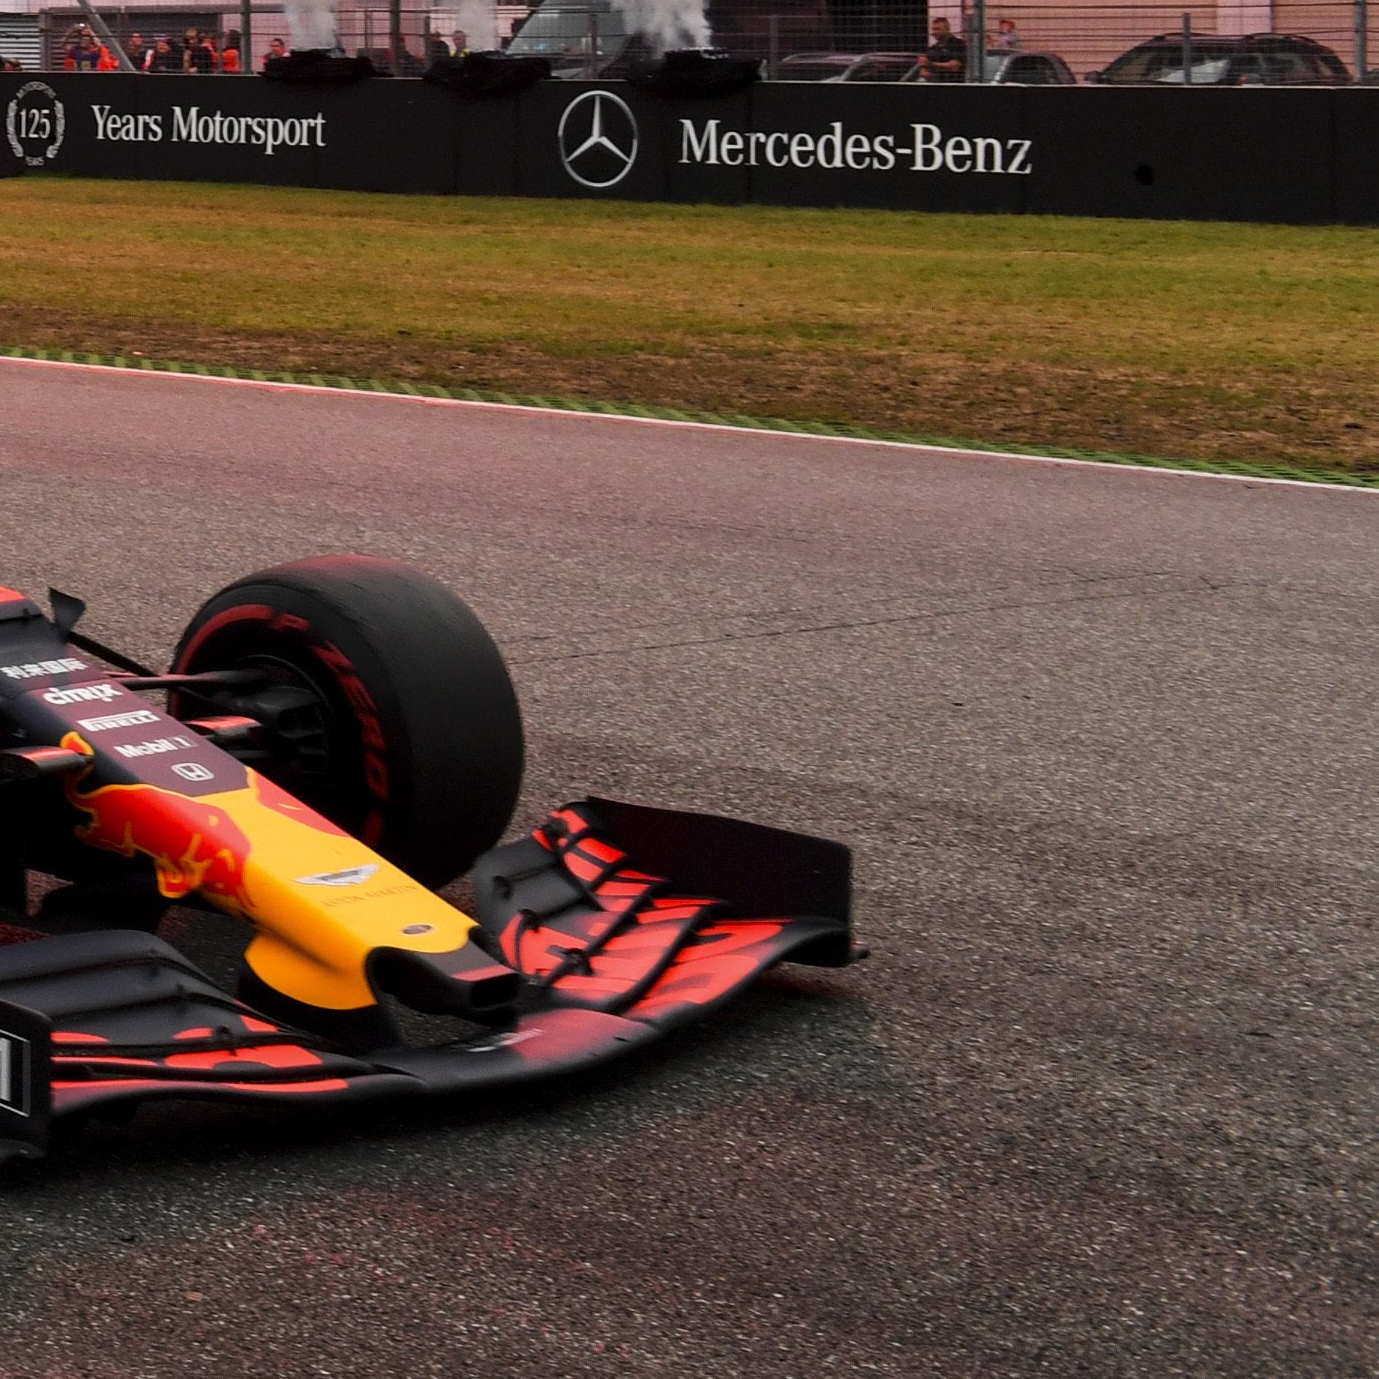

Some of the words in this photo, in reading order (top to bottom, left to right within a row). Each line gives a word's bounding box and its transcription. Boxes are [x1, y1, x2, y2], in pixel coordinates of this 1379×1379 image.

[19, 108, 51, 139] 125
[91, 104, 163, 142] Years
[171, 106, 327, 155] Motorsport
[679, 119, 1033, 174] Mercedes-Benz
[77, 710, 161, 732] PIRELLI
[113, 738, 177, 758] Mobil
